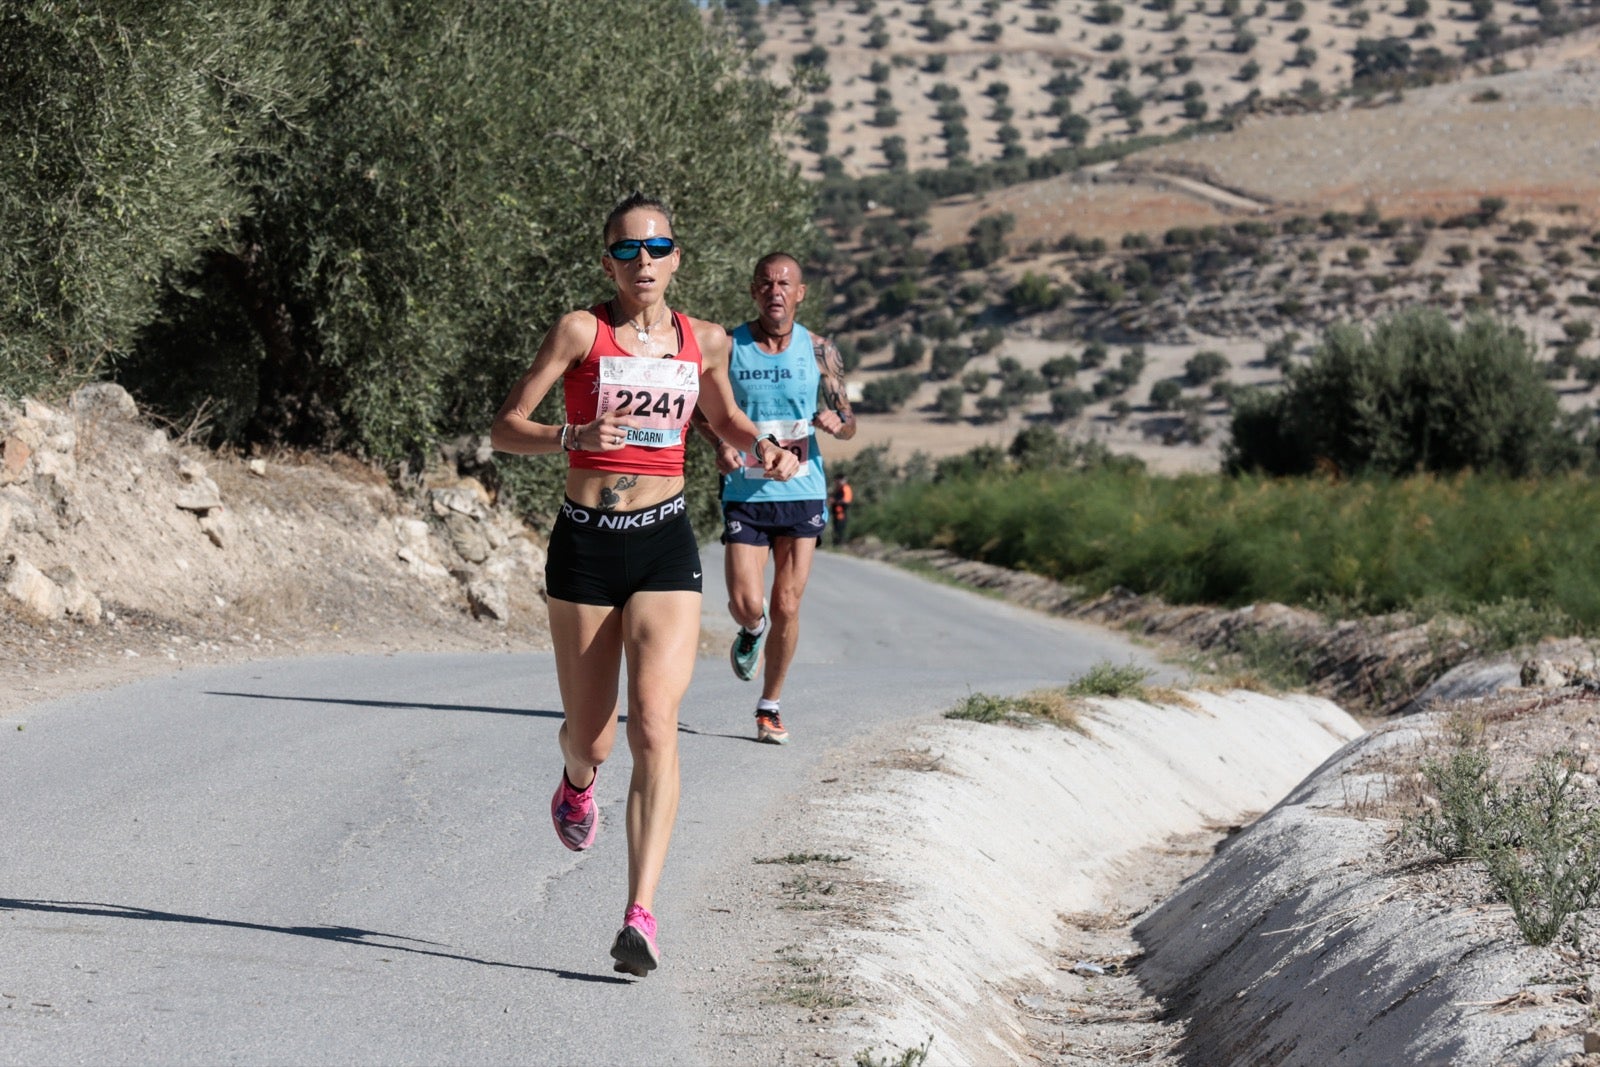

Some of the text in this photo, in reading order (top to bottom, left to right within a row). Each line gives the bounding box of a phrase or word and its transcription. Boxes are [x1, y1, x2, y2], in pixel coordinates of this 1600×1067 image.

[738, 365, 792, 383] nerja
[615, 390, 685, 420] 2241
[627, 429, 664, 443] ENCARNI
[597, 509, 657, 529] NIKE
[659, 494, 688, 521] PR
